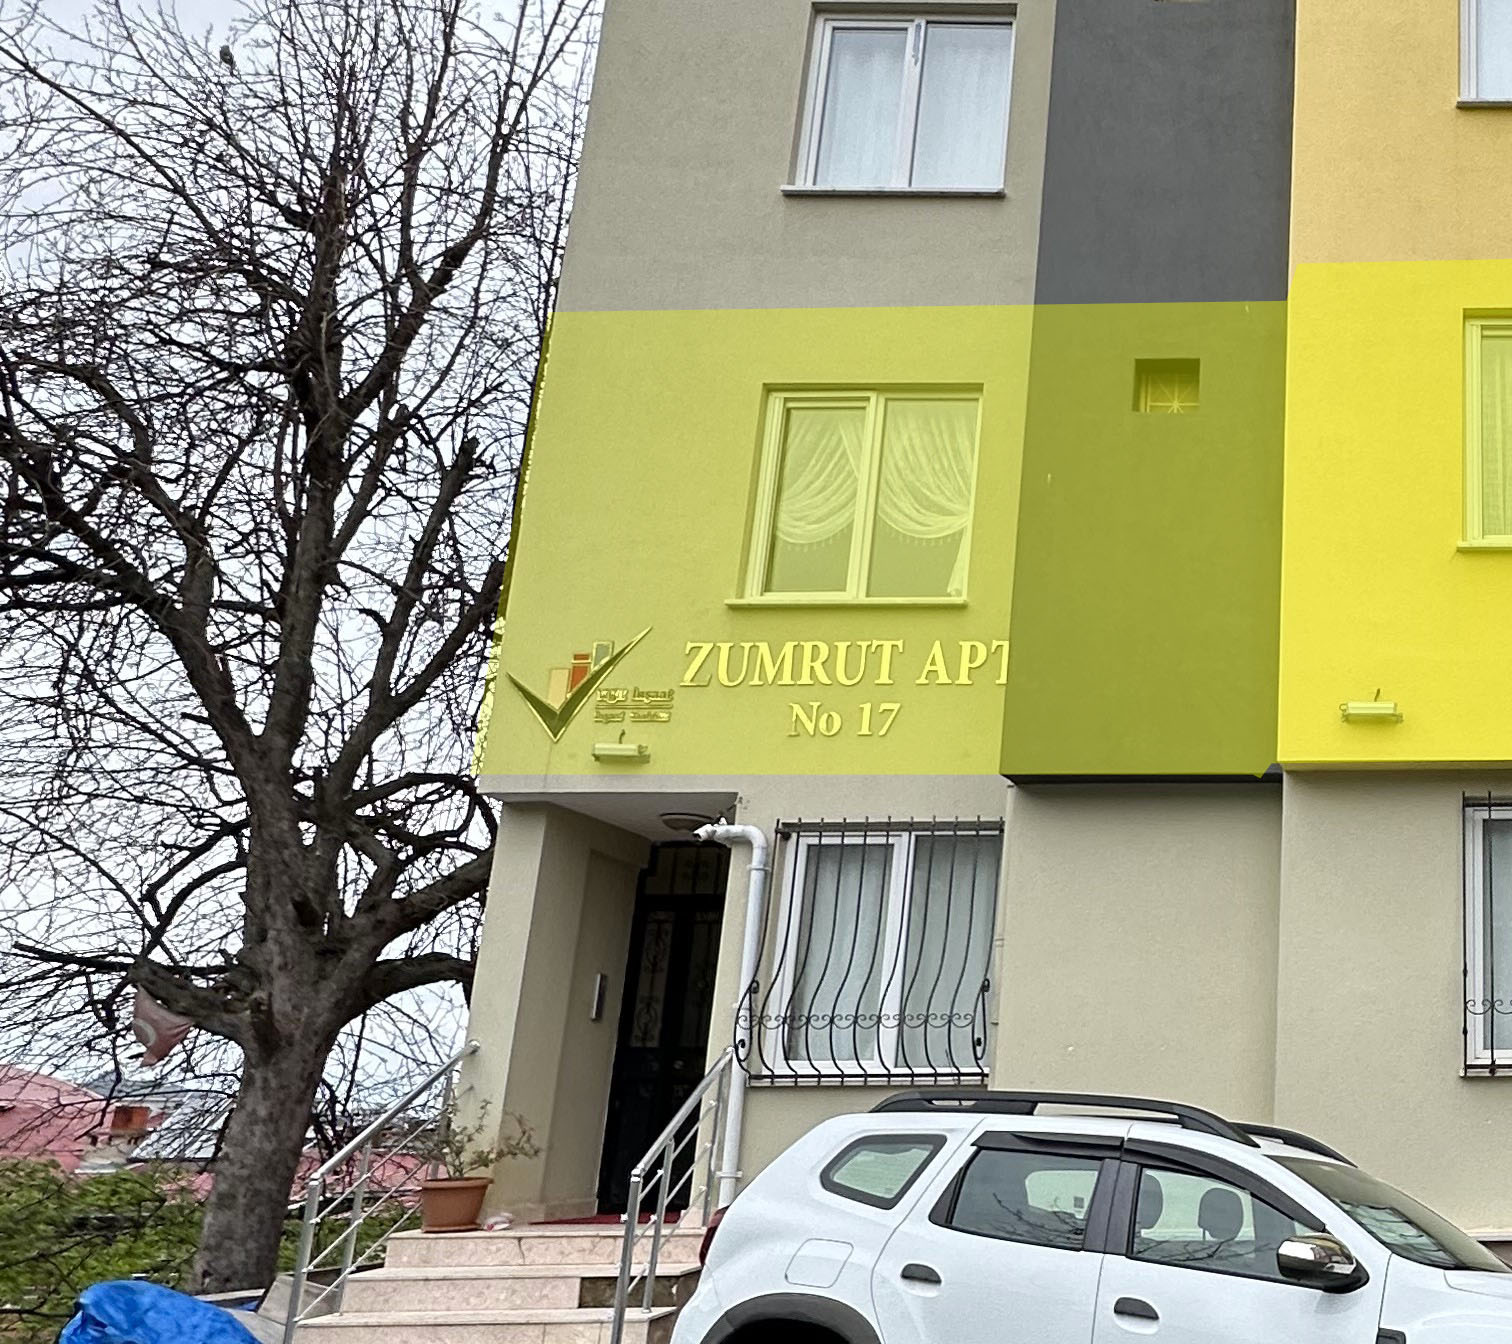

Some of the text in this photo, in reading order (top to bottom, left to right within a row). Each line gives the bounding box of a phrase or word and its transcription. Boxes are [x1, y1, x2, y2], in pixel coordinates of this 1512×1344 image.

[679, 639, 1010, 687] ZUMRUT APT
[788, 702, 901, 737] No 17
